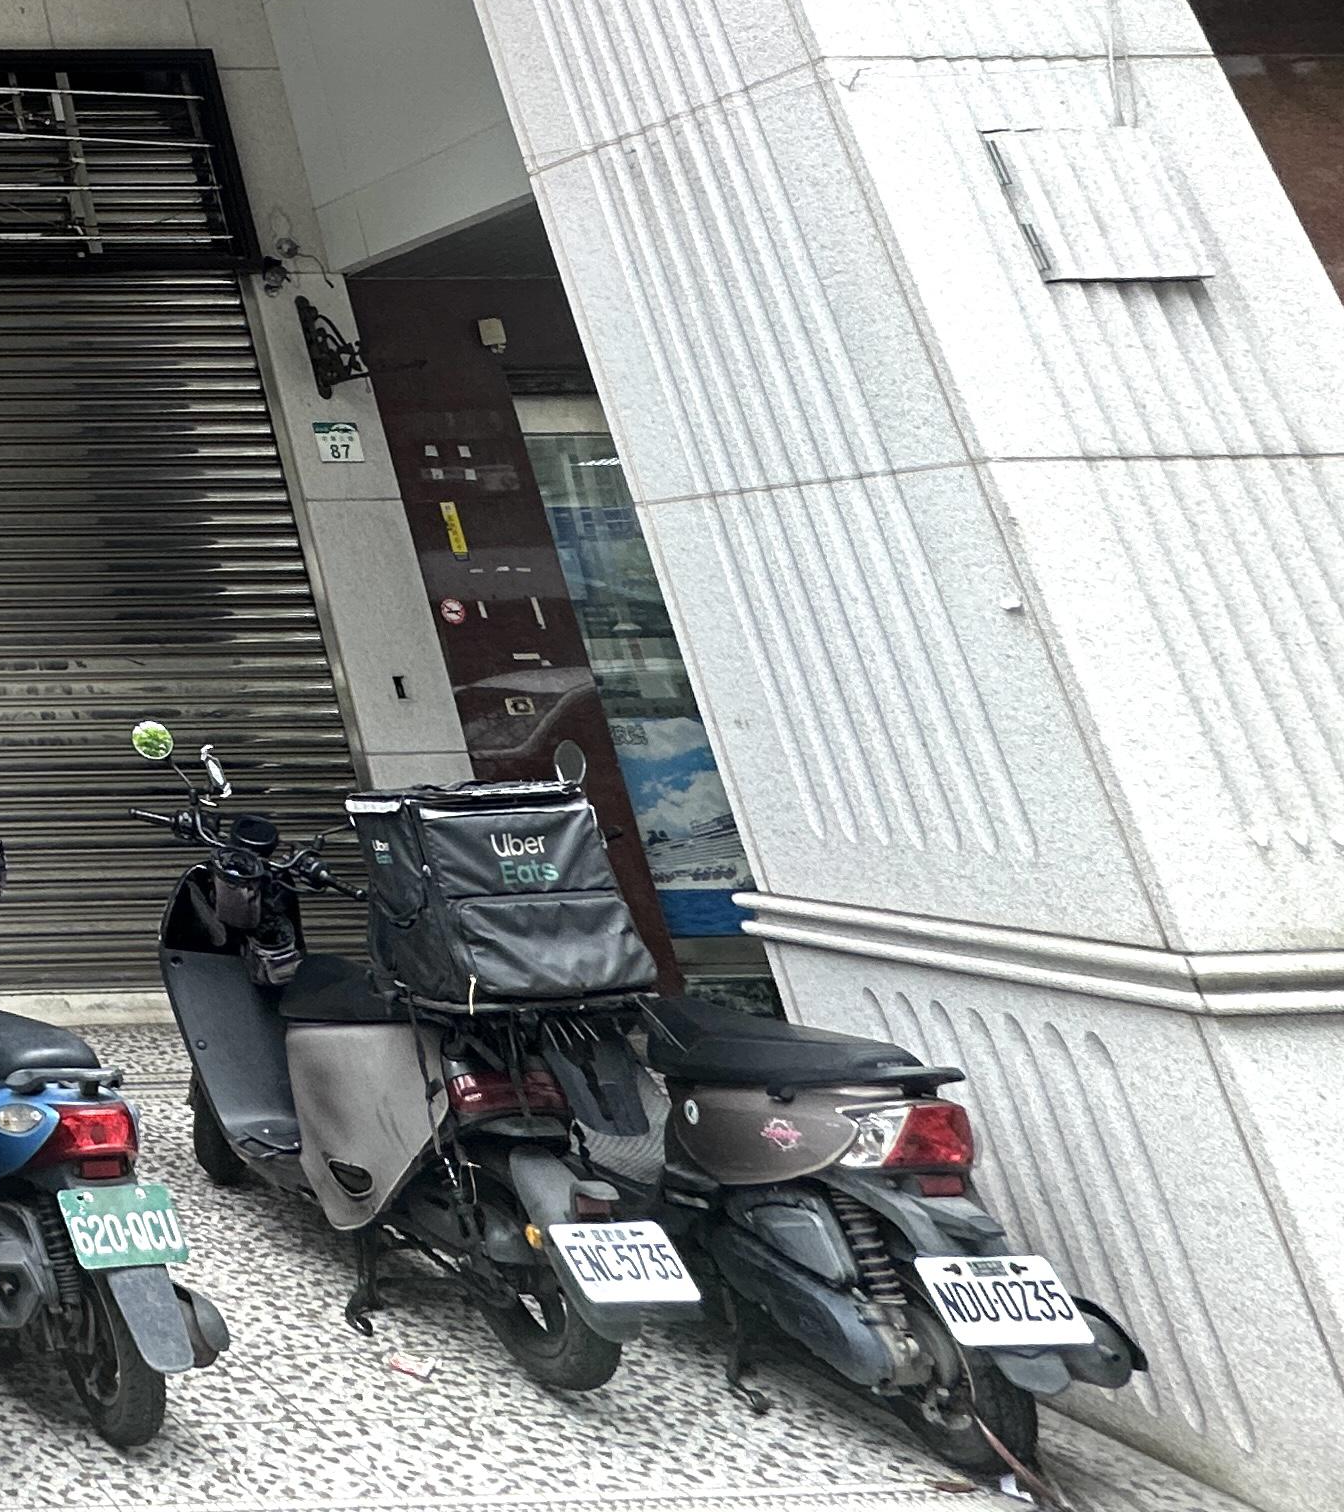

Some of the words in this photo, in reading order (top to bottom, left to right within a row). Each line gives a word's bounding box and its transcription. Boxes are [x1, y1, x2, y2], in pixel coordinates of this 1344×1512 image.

[329, 444, 351, 459] 87
[489, 833, 546, 858] Uber
[499, 859, 560, 885] Eats
